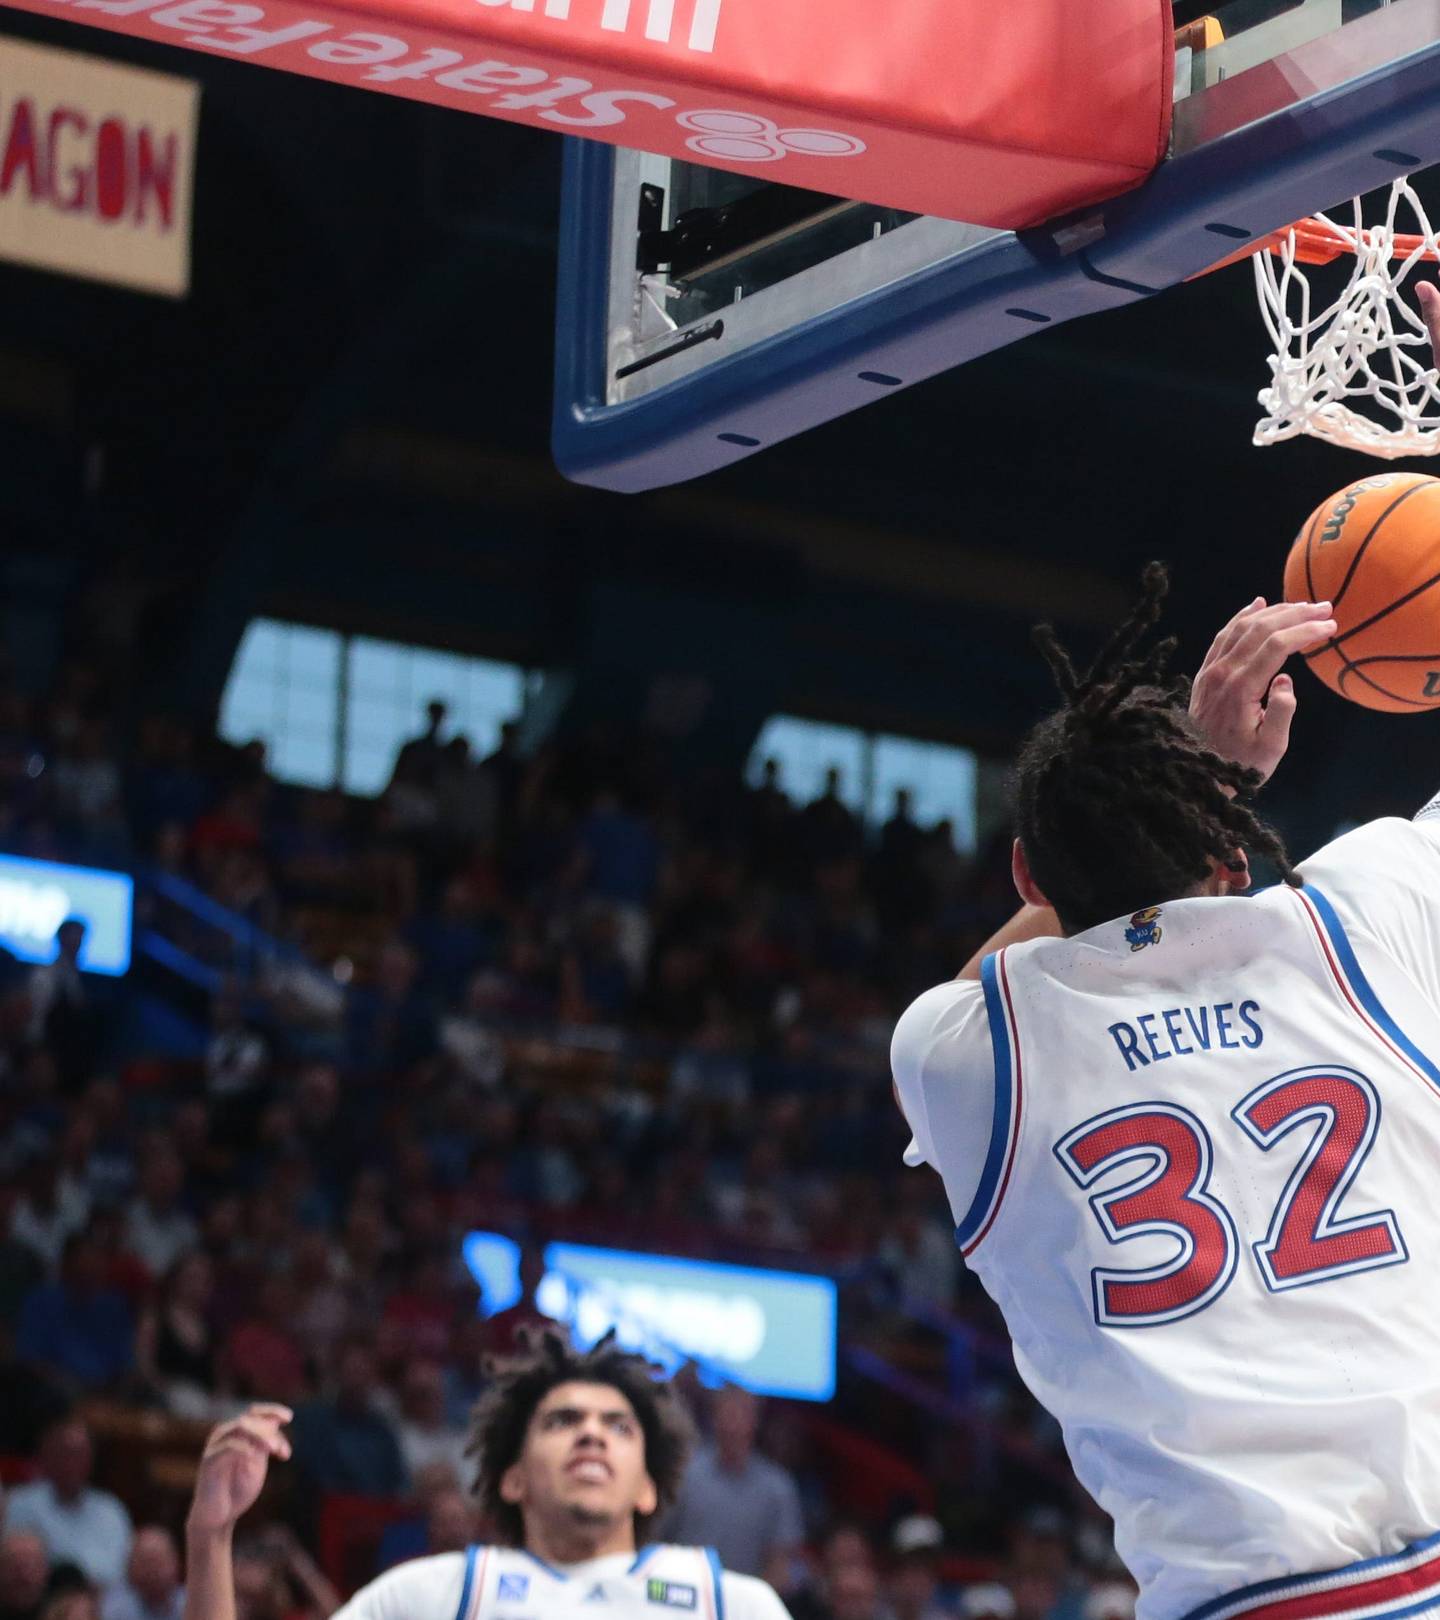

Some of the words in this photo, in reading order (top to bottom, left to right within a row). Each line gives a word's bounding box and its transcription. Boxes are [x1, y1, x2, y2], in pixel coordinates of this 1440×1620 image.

[307, 33, 677, 127] State
[1107, 999, 1264, 1071] REEVES
[1053, 1065, 1410, 1328] 32
